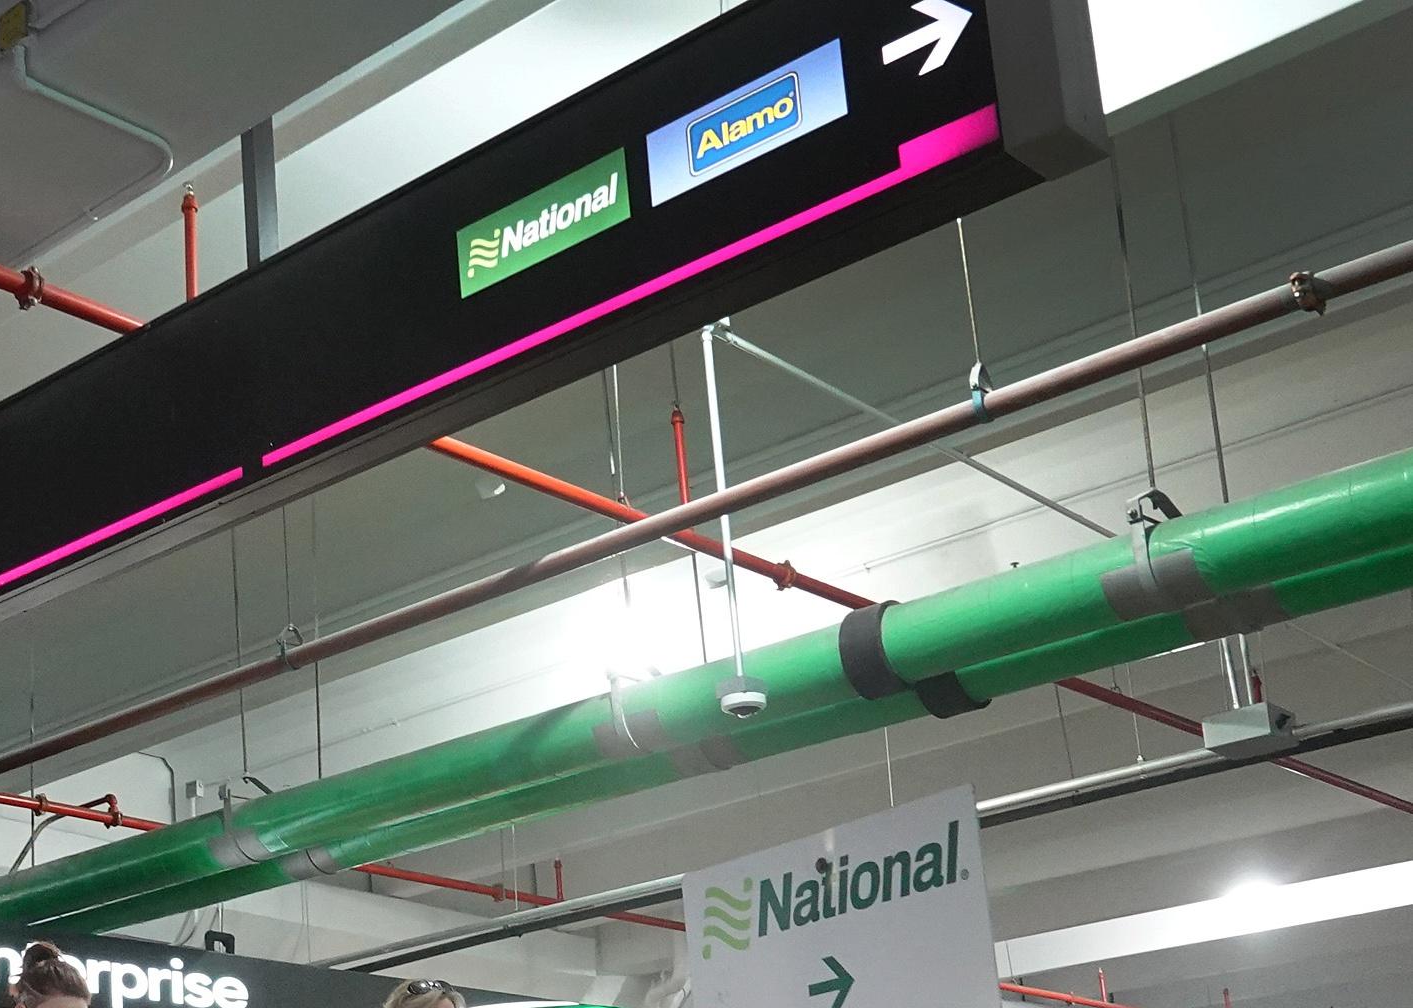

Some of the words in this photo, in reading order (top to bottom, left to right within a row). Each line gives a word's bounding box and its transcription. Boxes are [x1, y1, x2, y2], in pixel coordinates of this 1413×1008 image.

[695, 92, 796, 160] Alamo
[501, 173, 618, 258] National
[757, 820, 961, 938] National
